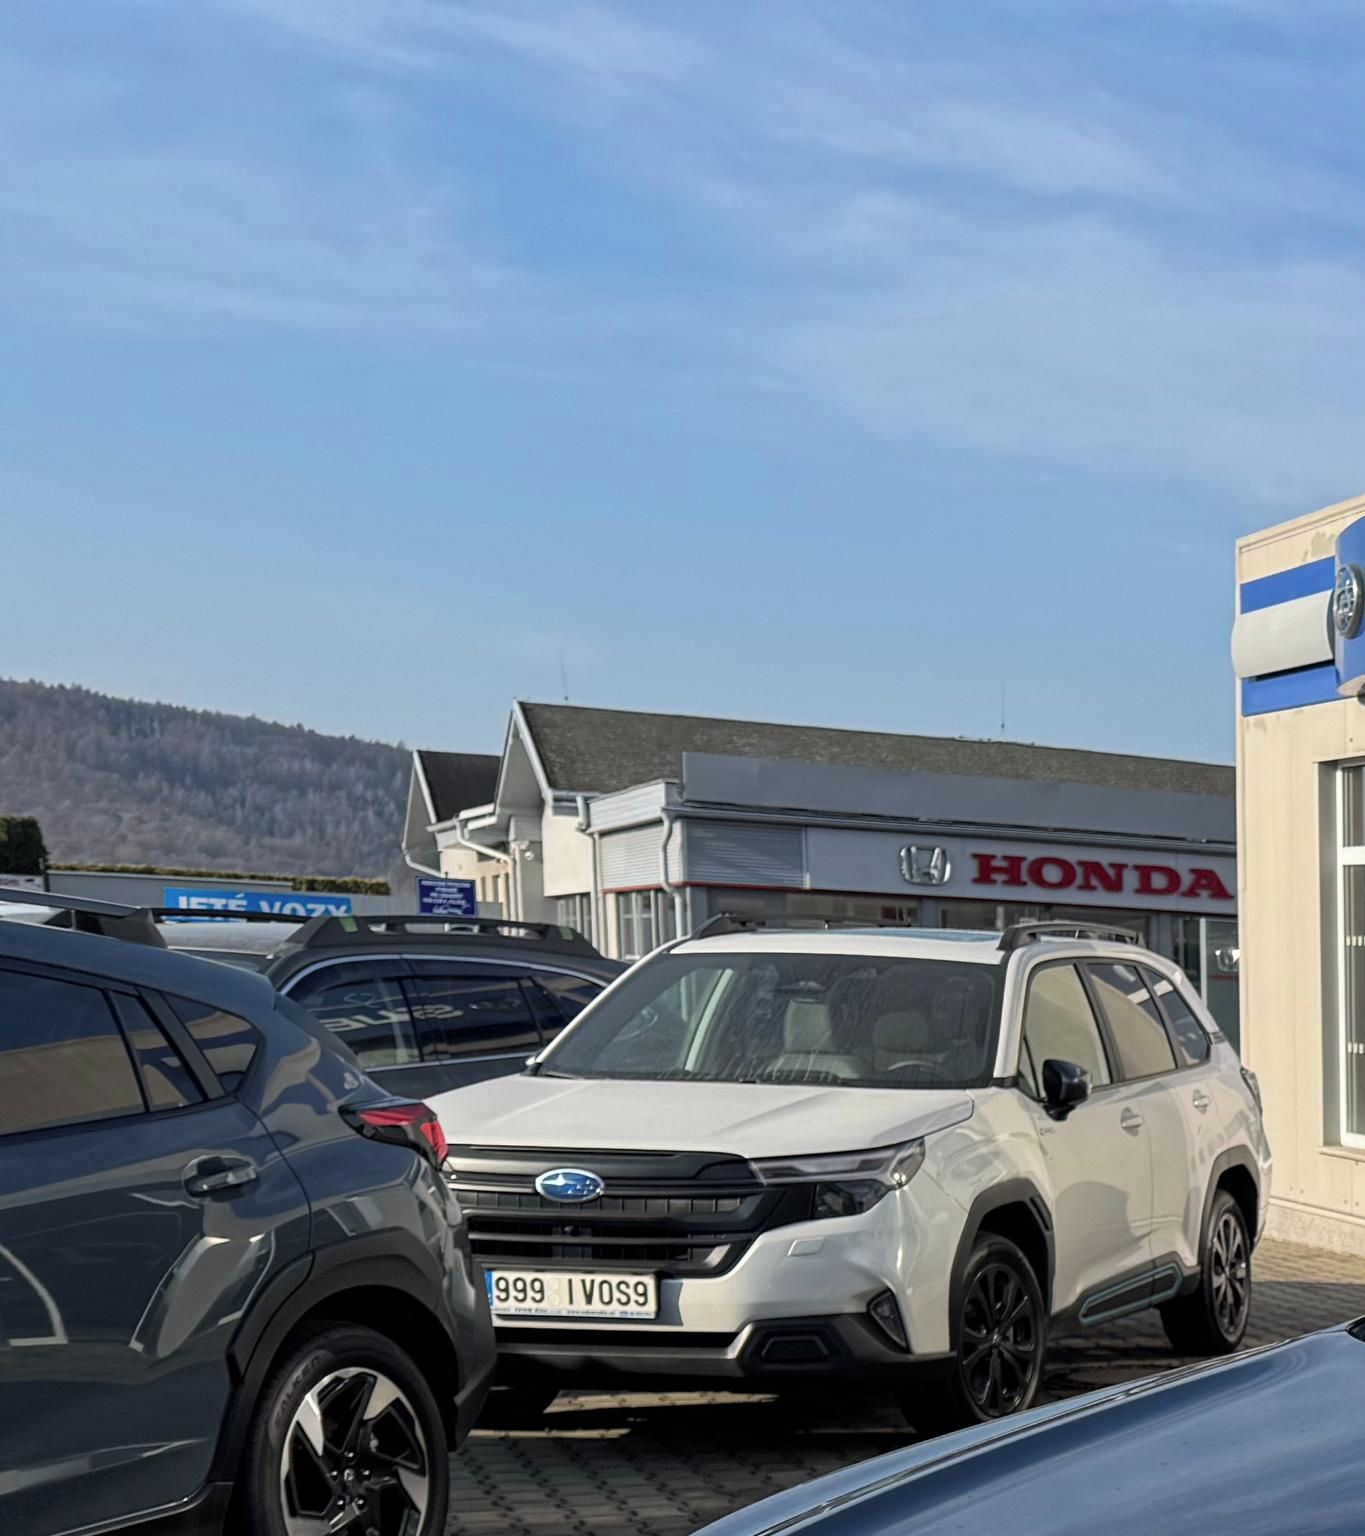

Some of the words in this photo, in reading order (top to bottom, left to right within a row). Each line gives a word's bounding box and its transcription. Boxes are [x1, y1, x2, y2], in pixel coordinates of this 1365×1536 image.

[971, 853, 1234, 900] HONDA
[494, 1277, 545, 1303] 999
[567, 1278, 649, 1306] IVOS9
